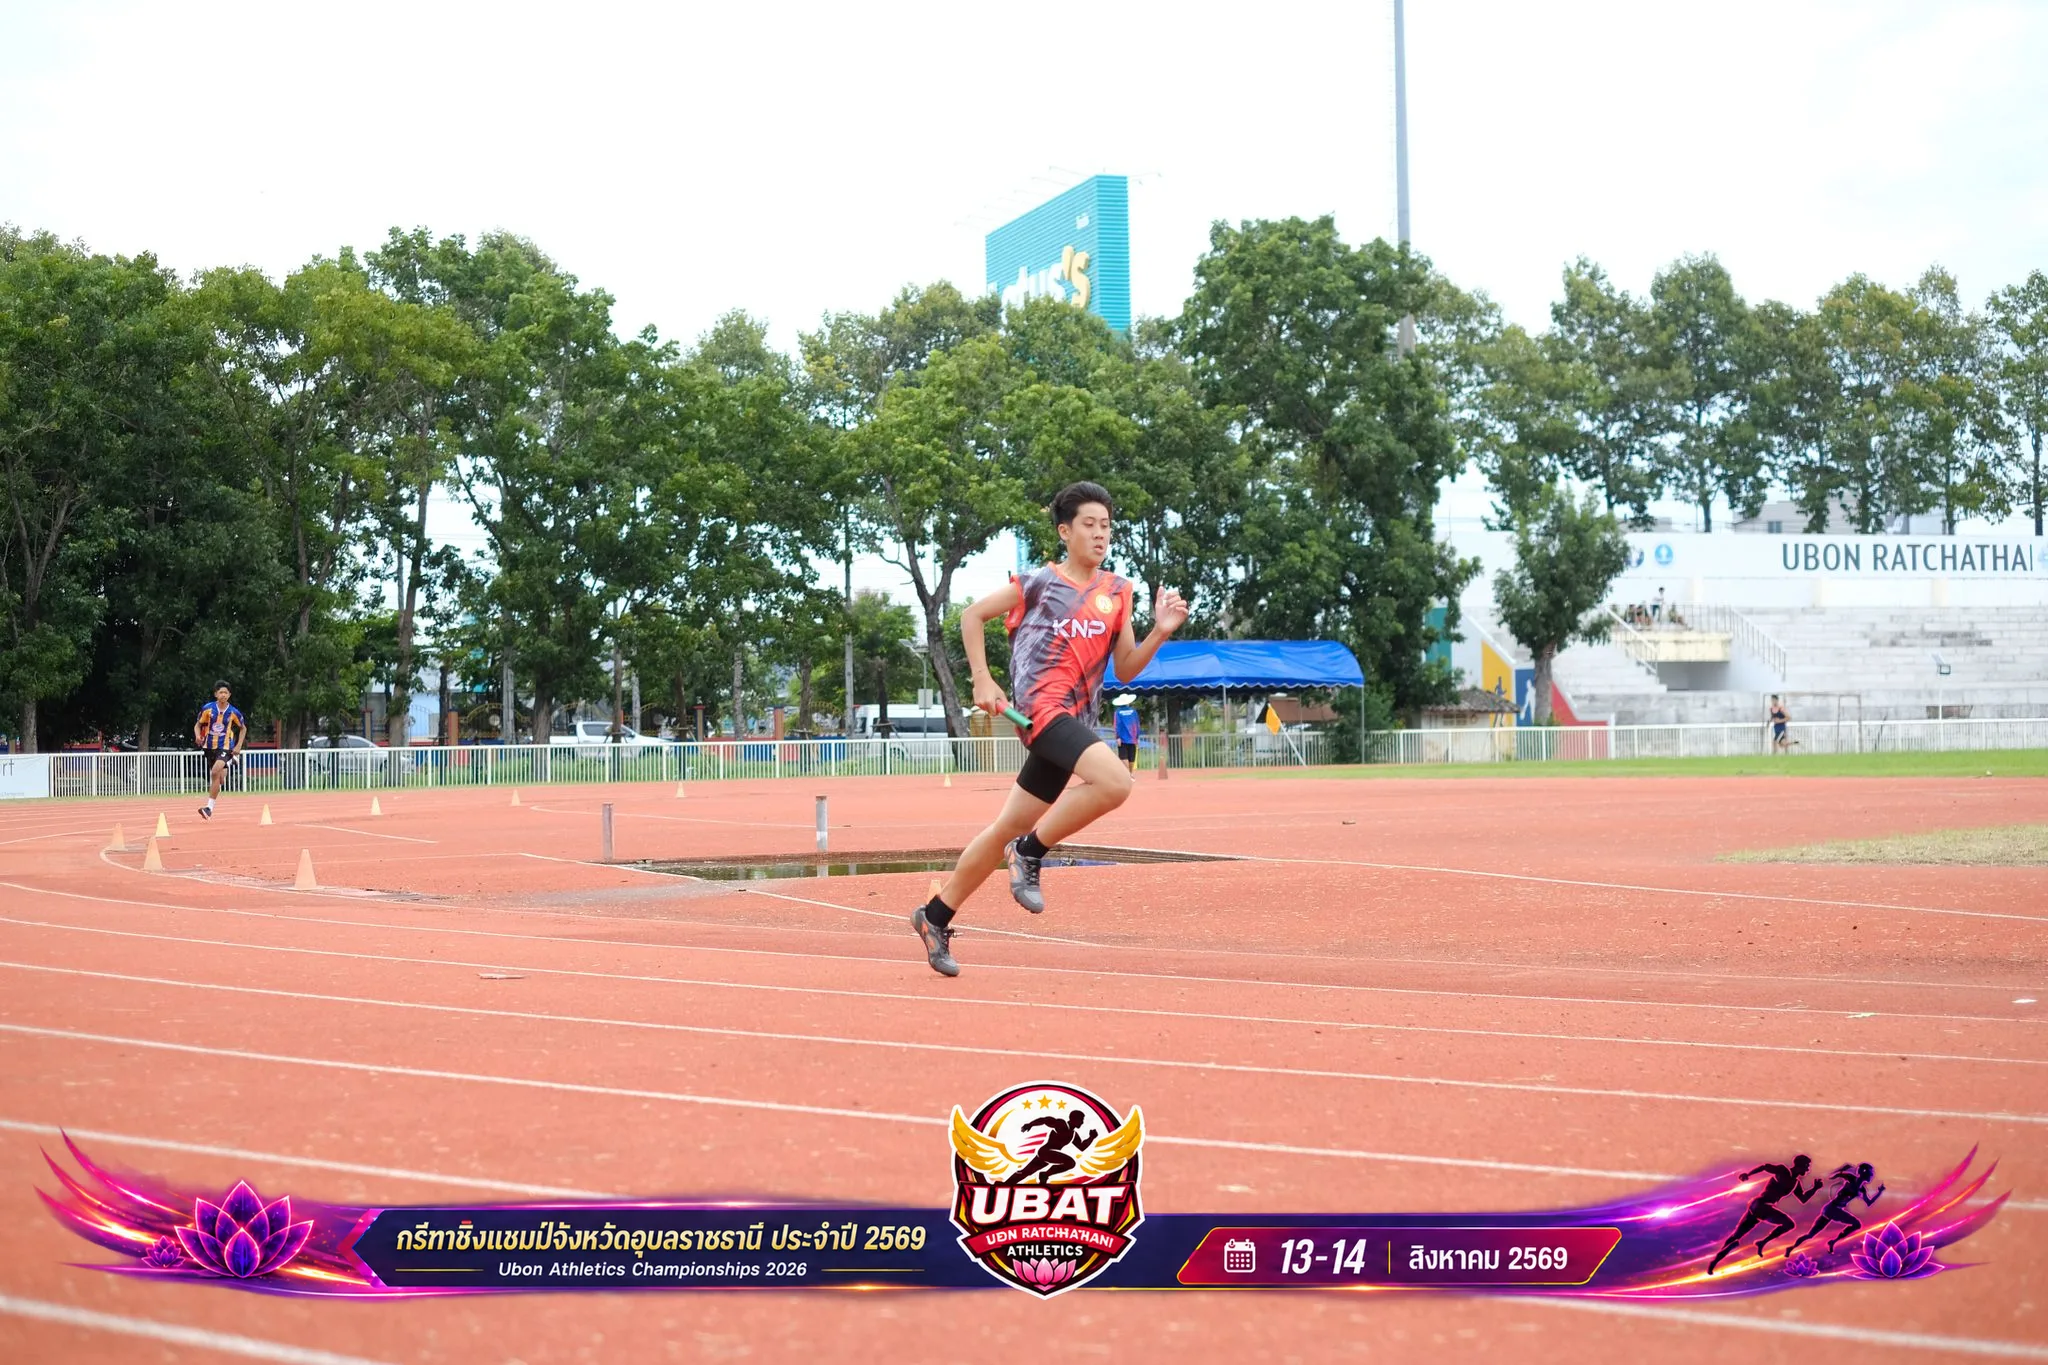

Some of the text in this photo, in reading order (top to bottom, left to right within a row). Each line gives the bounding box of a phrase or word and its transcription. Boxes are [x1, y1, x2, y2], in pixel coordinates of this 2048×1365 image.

[1783, 543, 2034, 571] UBON RATCHATHA
[1052, 618, 1106, 638] KNP
